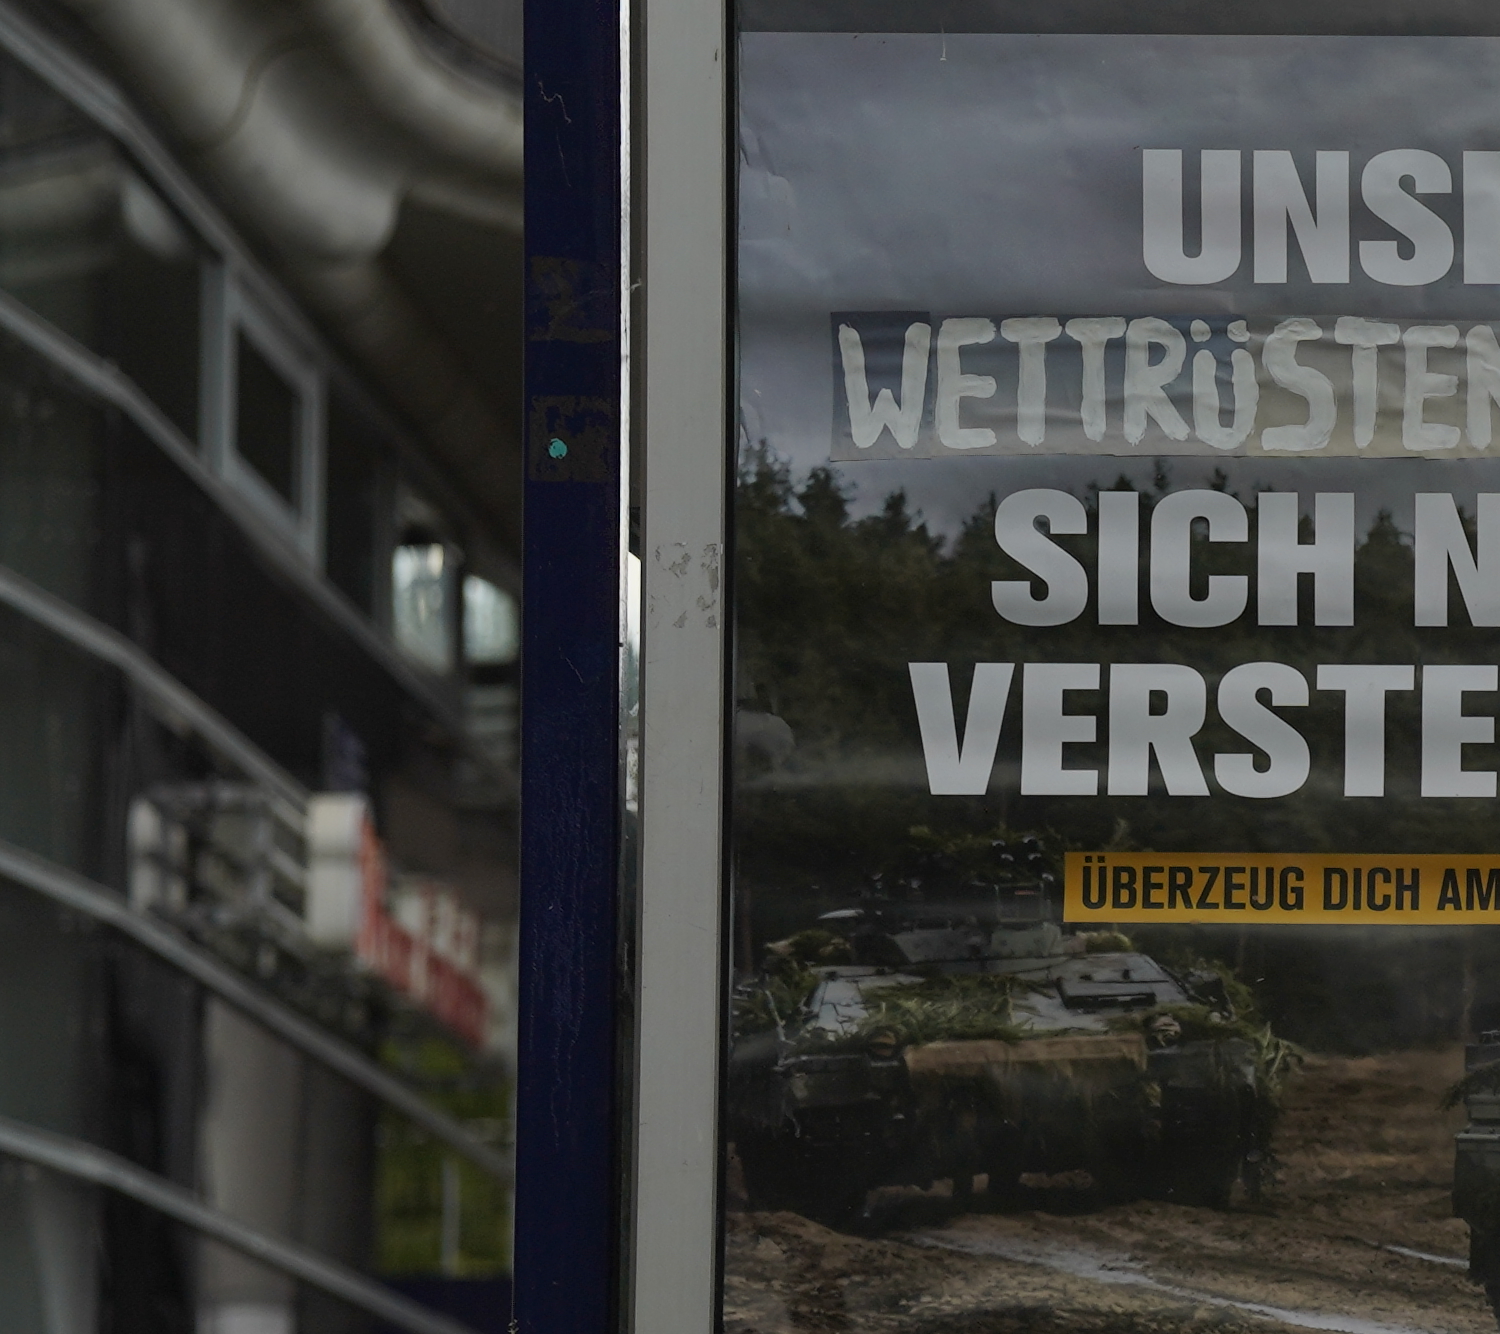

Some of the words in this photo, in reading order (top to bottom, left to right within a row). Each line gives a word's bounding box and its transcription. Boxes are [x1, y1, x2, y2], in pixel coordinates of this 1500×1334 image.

[991, 488, 1356, 628] SICH
[1082, 854, 1305, 911] ÜBERZEUG
[1322, 866, 1420, 912] DICH
